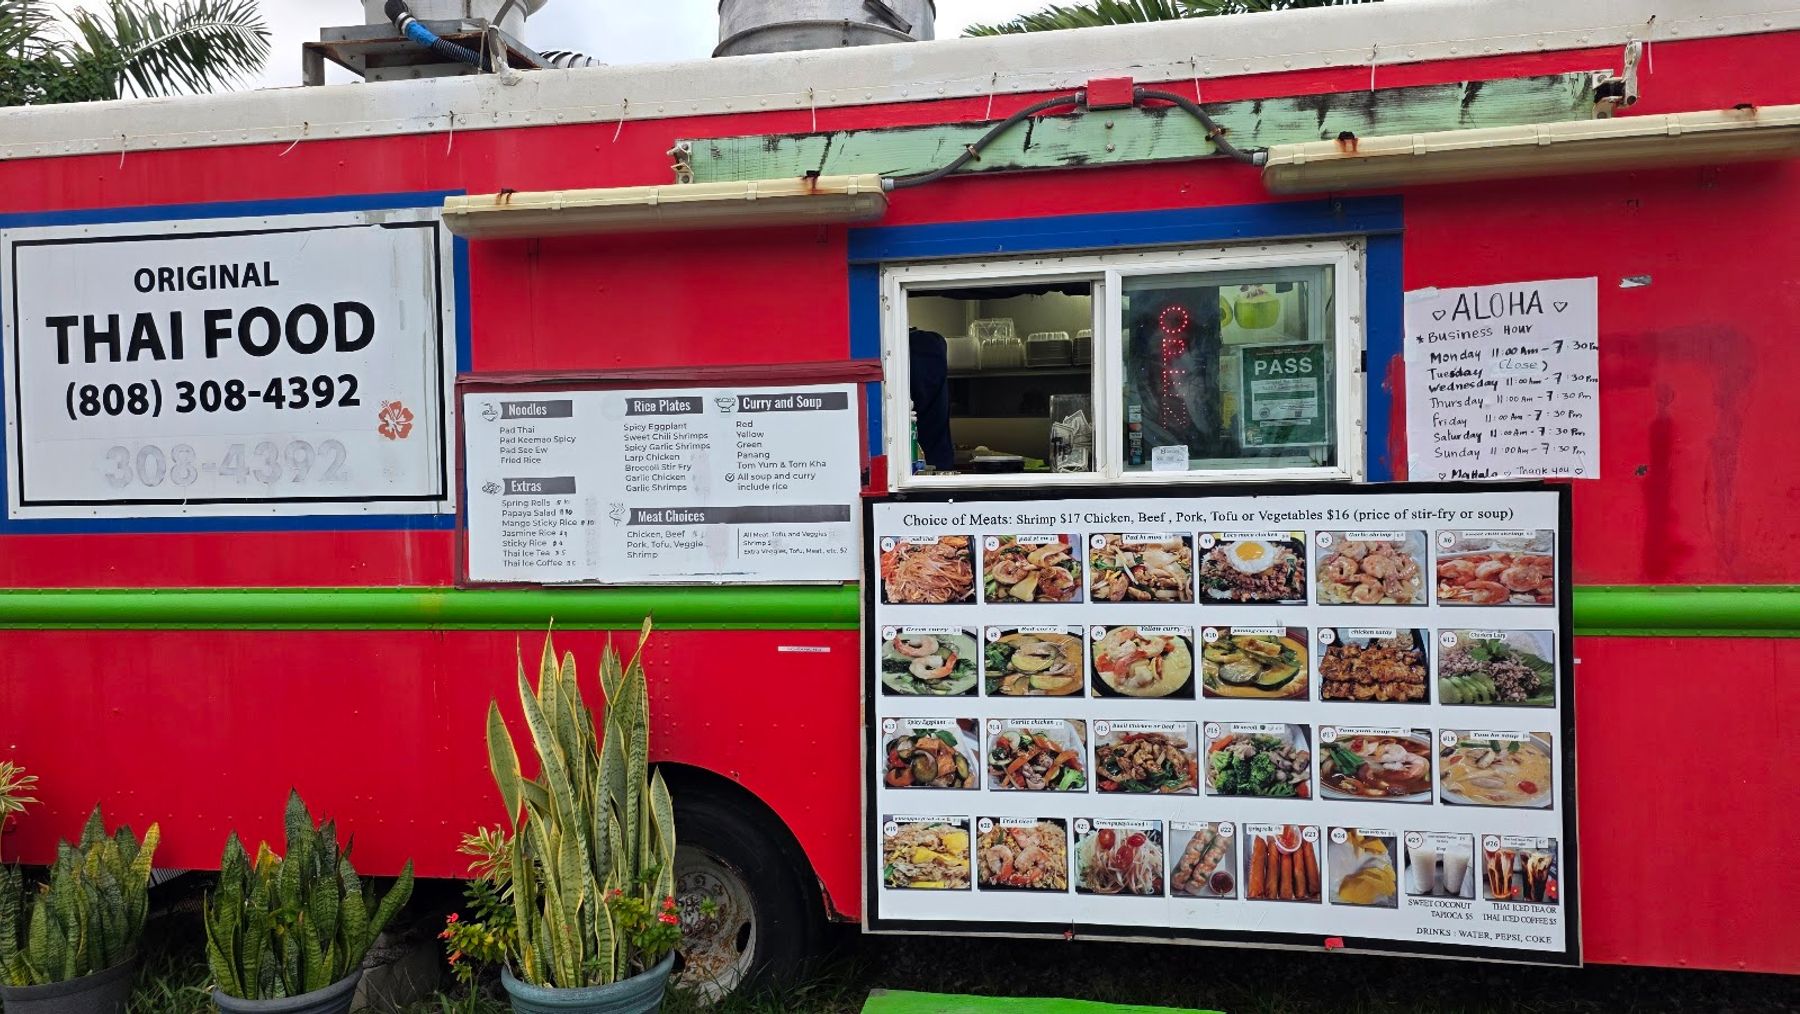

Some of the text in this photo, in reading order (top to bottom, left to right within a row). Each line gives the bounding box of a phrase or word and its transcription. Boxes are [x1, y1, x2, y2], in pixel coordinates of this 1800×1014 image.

[134, 261, 279, 293] ORIGINAL
[1452, 289, 1544, 322] ALOHA
[45, 301, 375, 364] THAI FOOD
[1428, 327, 1493, 343] Business
[1430, 349, 1481, 364] Monday
[1160, 306, 1188, 429] OPEN
[1254, 357, 1313, 376] PASS
[1428, 368, 1483, 380] Tuesday
[66, 374, 360, 420] (808) 308-4392
[634, 399, 691, 412] Rice Plates
[743, 396, 822, 410] Curry and Soup
[1430, 397, 1484, 409] Thursday
[508, 404, 547, 416] Noodles
[624, 422, 687, 432] Spicy Eggplant
[736, 420, 753, 428] Red
[517, 426, 535, 434] Thai
[554, 435, 576, 444] Spicy
[652, 432, 671, 440] Chili
[673, 432, 709, 440] Shrimps
[1434, 430, 1482, 443] Saturday
[500, 446, 516, 454] Pad
[624, 442, 711, 452] Spicy Garlic Shrimps
[624, 453, 680, 462] Larp Chicken
[737, 451, 770, 460] Panang
[1434, 447, 1480, 460] Sunday
[105, 439, 348, 488] 308-4392
[501, 456, 541, 464] Fried Rice
[737, 461, 756, 469] Tom
[758, 461, 778, 469] Yum
[788, 460, 807, 468] Tom
[809, 460, 827, 468] Kha
[625, 464, 659, 472] Broccoli
[661, 463, 676, 471] Stir
[625, 473, 686, 482] Garlic Chicken
[737, 473, 749, 481] All
[774, 472, 791, 480] and
[511, 480, 542, 493] Extras
[626, 484, 687, 492] Garlic Shrimps
[738, 482, 788, 491] include rice
[502, 499, 529, 508] Spring
[531, 499, 550, 507] Rolls
[502, 510, 532, 518] Papaya
[534, 509, 556, 517] Salad
[638, 510, 705, 523] Meat Choices
[903, 514, 948, 526] Choice
[952, 514, 966, 525] of
[970, 514, 1012, 525] Meats:
[1016, 513, 1056, 527] Shrimp
[1060, 513, 1080, 525] $17
[1084, 512, 1134, 525] Chicken,
[1177, 512, 1207, 524] Pork,
[1210, 510, 1238, 521] Tofu
[1242, 513, 1255, 521] or
[1258, 510, 1323, 523] Vegetables
[1326, 509, 1349, 521] $16
[1354, 509, 1390, 523] (price
[1394, 508, 1409, 520] of
[1411, 508, 1456, 522] stir-fry
[1460, 511, 1474, 519] or
[1477, 508, 1514, 521] soup)
[502, 520, 531, 528] Mango
[532, 519, 557, 527] Sticky
[502, 529, 536, 537] Jasmine
[627, 530, 685, 538] Chicken, Beef
[502, 539, 527, 548] Sticky
[529, 539, 547, 547] Rice
[673, 540, 704, 549] Veggie
[504, 549, 520, 557] Thai
[522, 549, 534, 557] Ice
[627, 550, 658, 559] Shrimp
[504, 559, 520, 567] Thai
[536, 559, 563, 567] Coffee
[1408, 899, 1472, 910] SWEET COCONUT
[1492, 902, 1557, 914] THAI ICED TEA OR
[1431, 910, 1473, 920] TAPIOCA $5
[1483, 914, 1501, 922] THAI
[1502, 915, 1520, 923] ICED
[1521, 916, 1548, 925] COFFEE
[1416, 927, 1552, 944] DRINKS WATER, PEPSI, COKE
